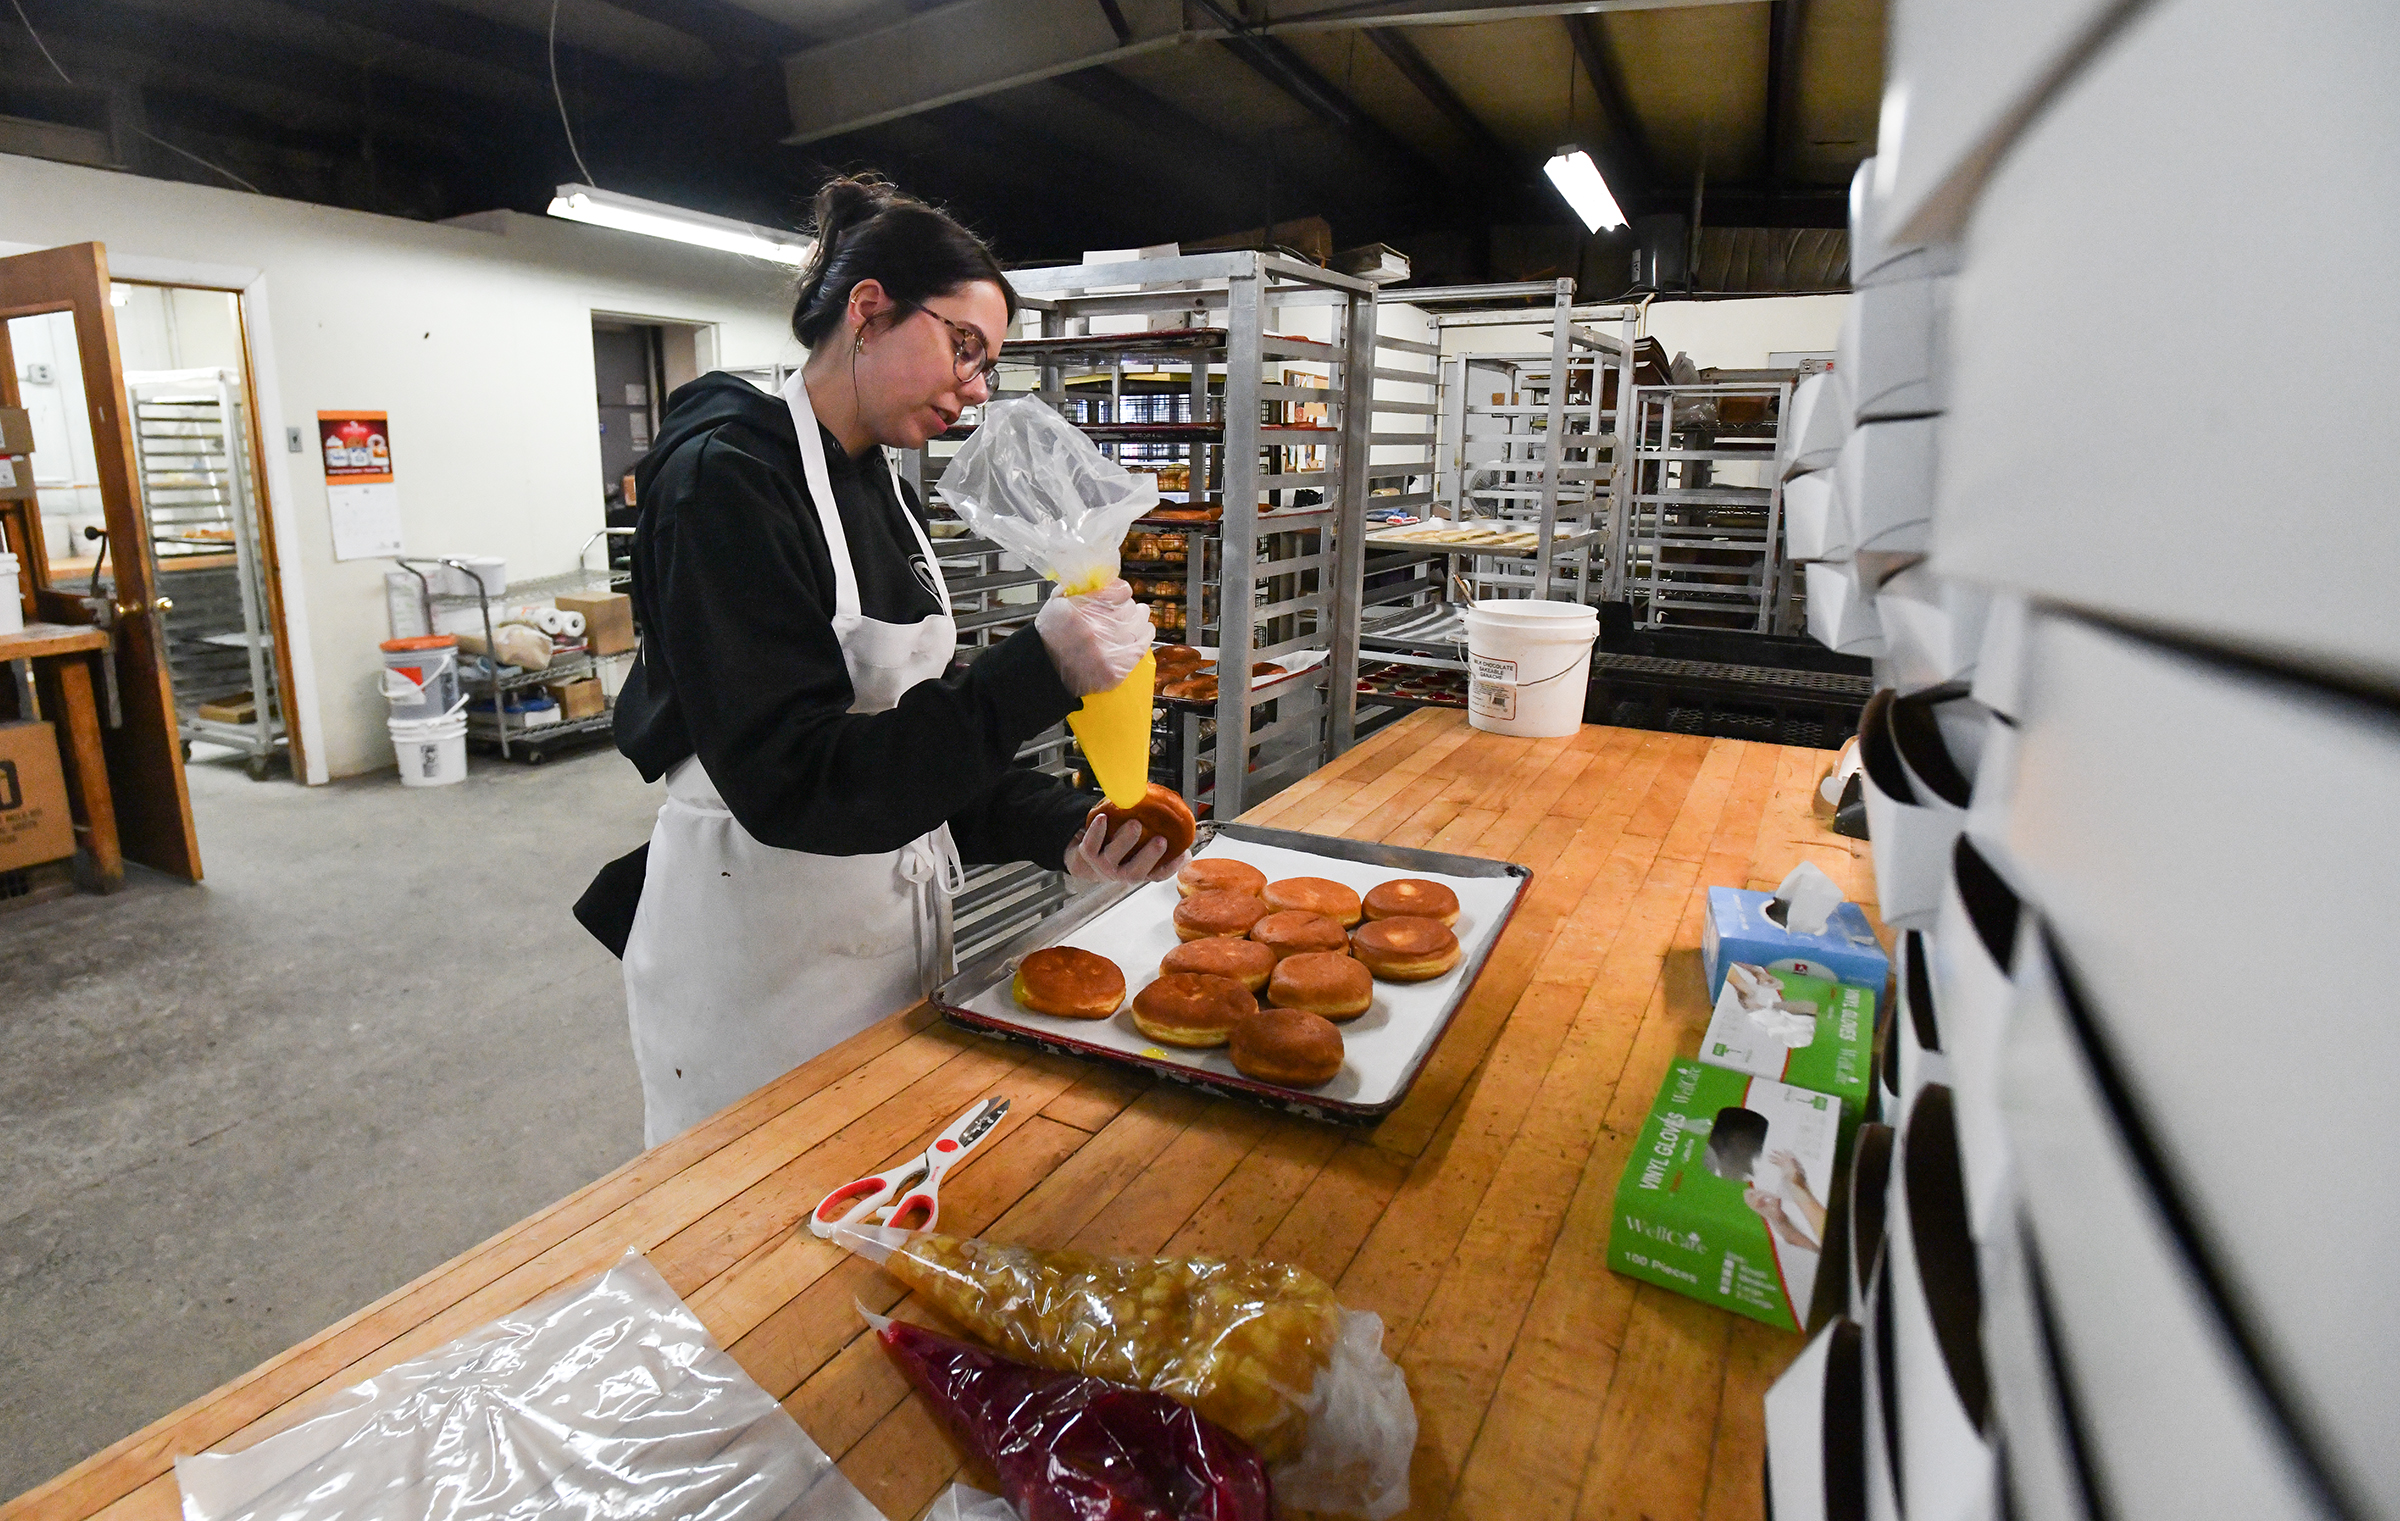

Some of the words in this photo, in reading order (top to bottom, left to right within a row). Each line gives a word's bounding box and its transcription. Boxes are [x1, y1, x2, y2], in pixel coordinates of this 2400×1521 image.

[1483, 661, 1514, 671] CHOCOLATE
[1639, 1157, 1669, 1190] VINYL
[1654, 1111, 1687, 1156] GLOVES
[1651, 1259, 1698, 1284] Pieces
